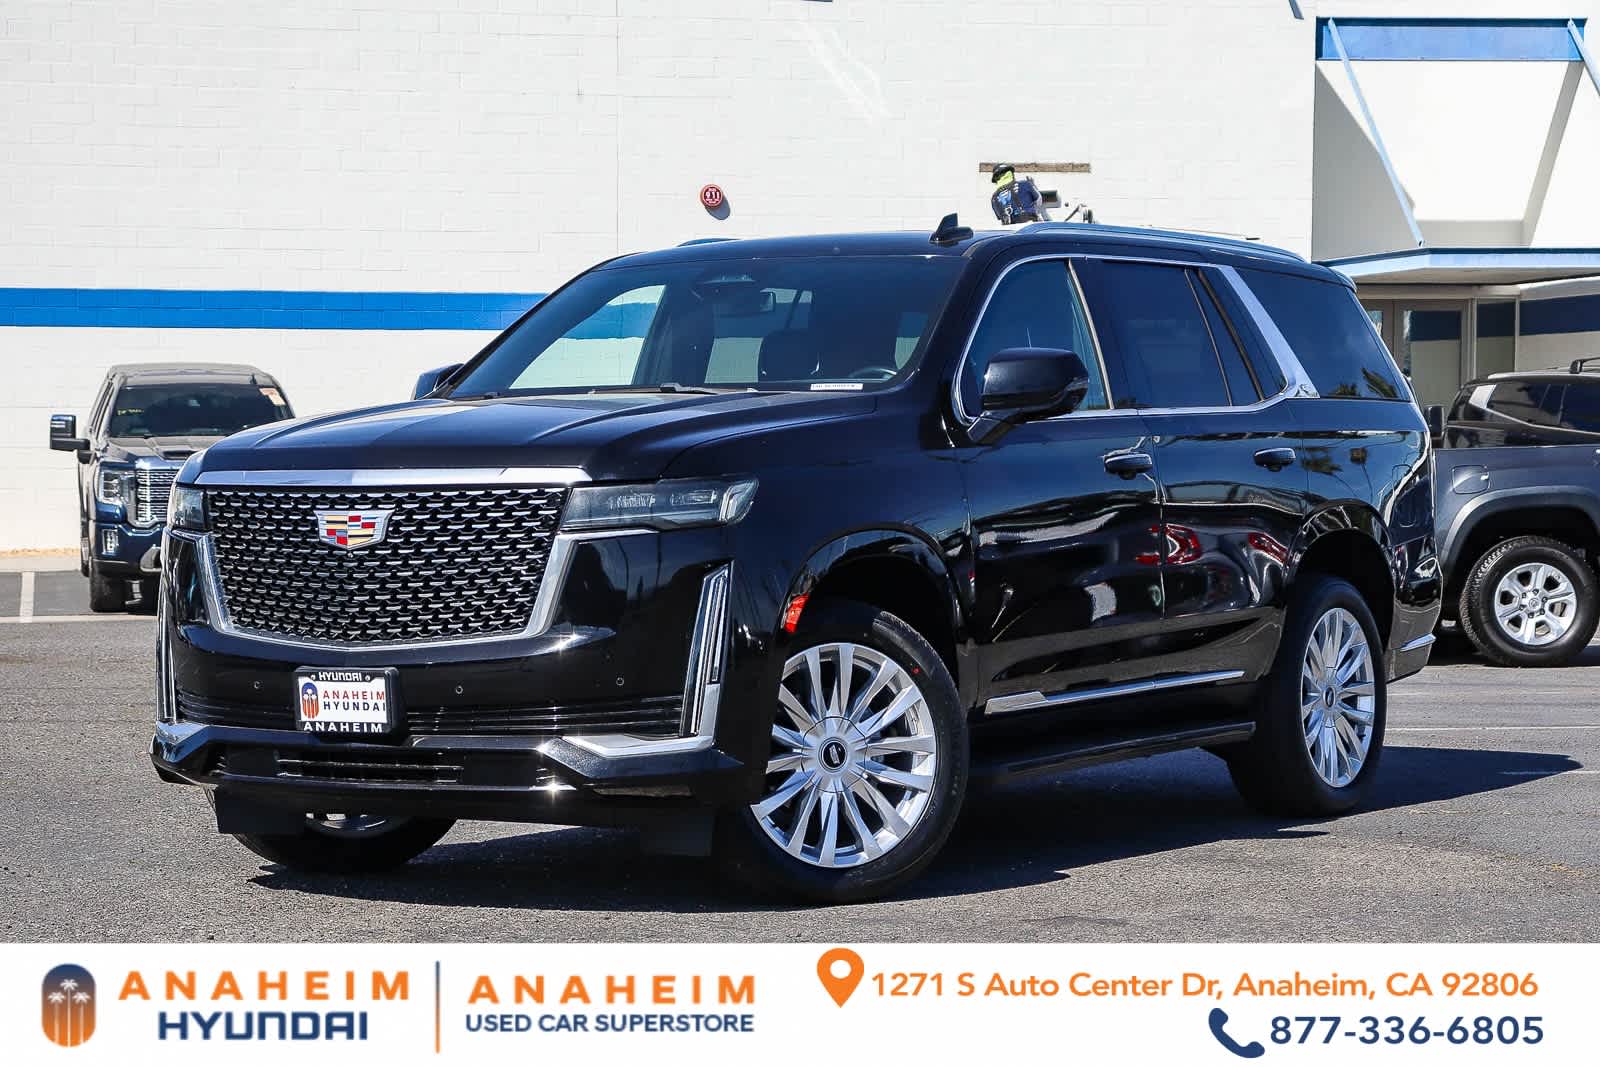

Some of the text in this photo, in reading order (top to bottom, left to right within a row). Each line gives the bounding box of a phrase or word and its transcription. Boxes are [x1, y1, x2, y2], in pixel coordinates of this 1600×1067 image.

[318, 672, 362, 681] HYUNDAI
[322, 690, 385, 700] ANAHEIM
[323, 701, 386, 711] HYUNDAI
[303, 721, 383, 733] ANAHEIM
